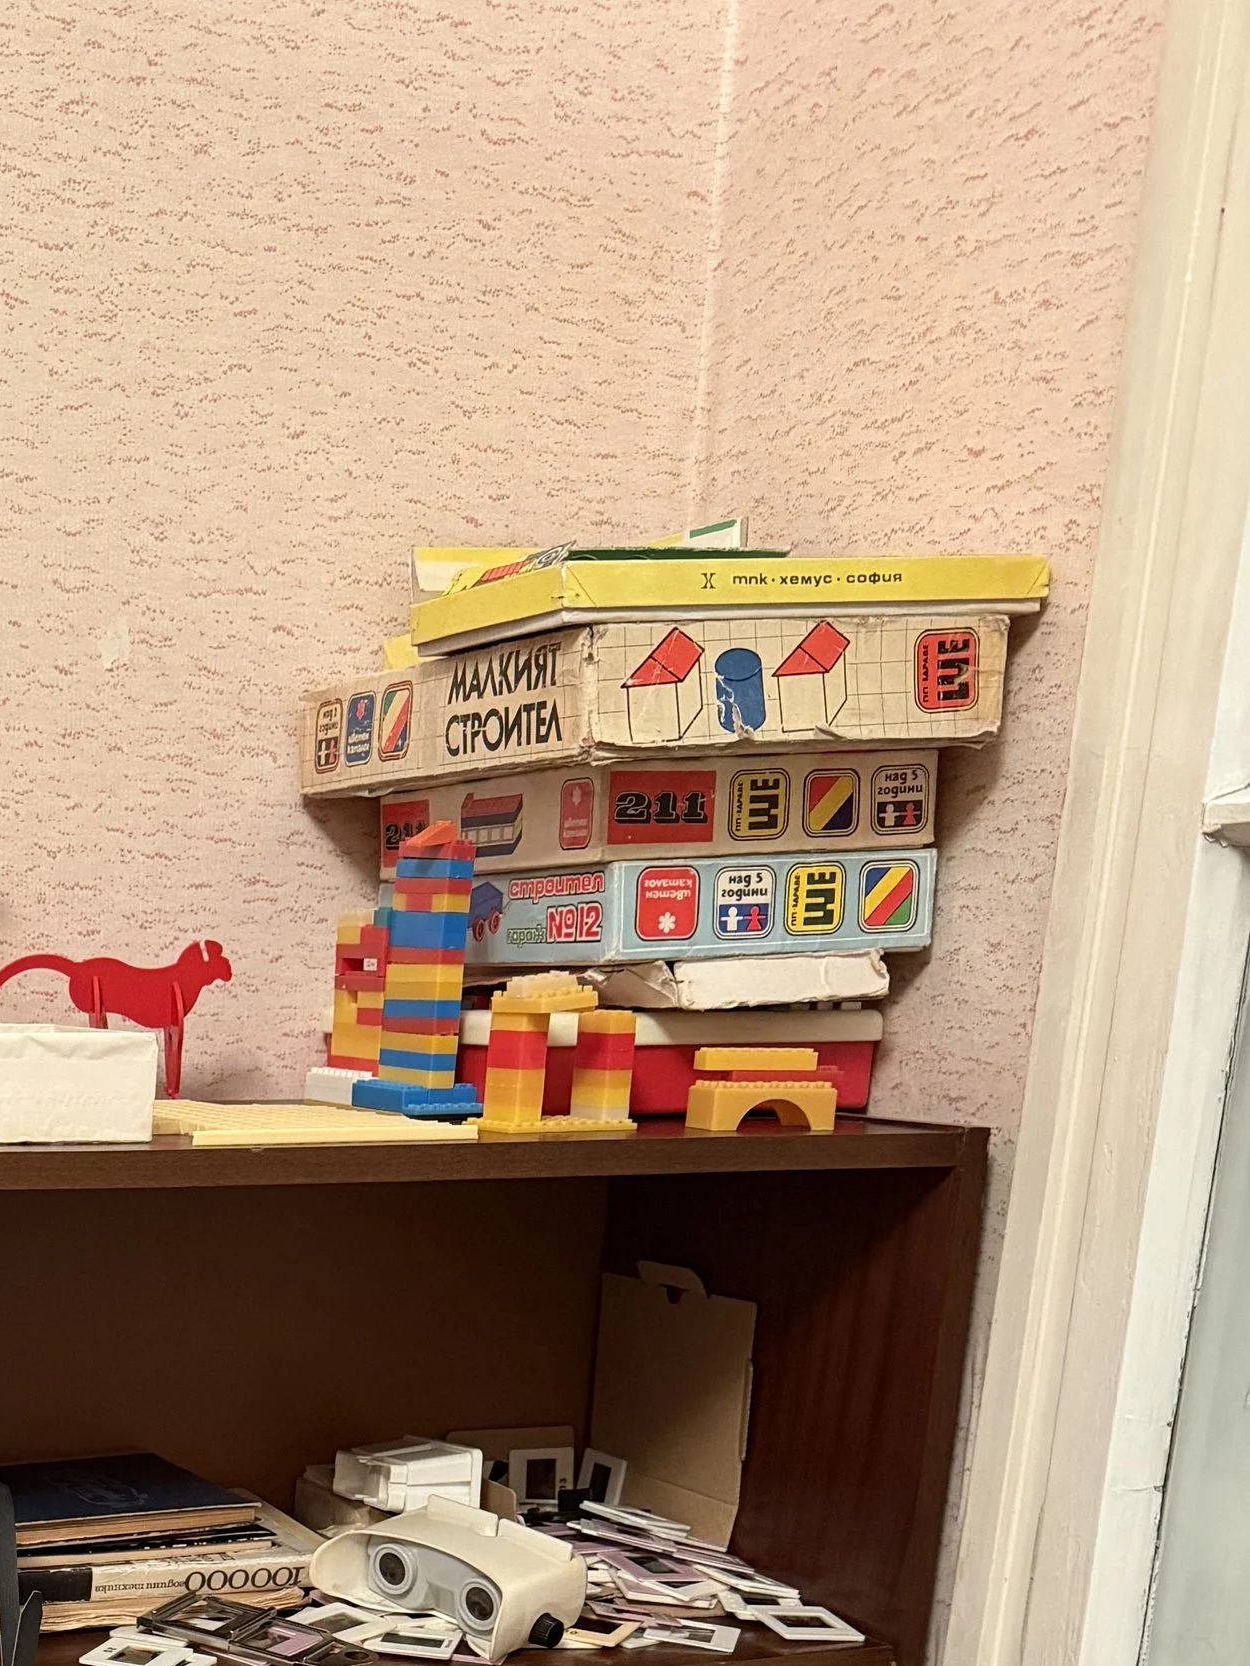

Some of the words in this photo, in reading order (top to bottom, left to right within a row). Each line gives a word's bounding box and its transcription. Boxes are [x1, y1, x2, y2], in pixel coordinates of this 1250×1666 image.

[779, 574, 833, 588] хемус
[846, 571, 903, 586] софия
[447, 641, 562, 706] МАЛКИЯТ
[445, 698, 563, 757] СТРОИТЕЛ
[884, 771, 907, 785] над
[911, 769, 918, 781] 5
[877, 784, 923, 799] години
[614, 791, 708, 824] 211
[643, 878, 693, 888] каталог
[728, 873, 751, 887] над
[755, 871, 763, 883] 5
[645, 889, 692, 901] цветен
[721, 887, 769, 902] години
[184, 1565, 306, 1592] 100000
